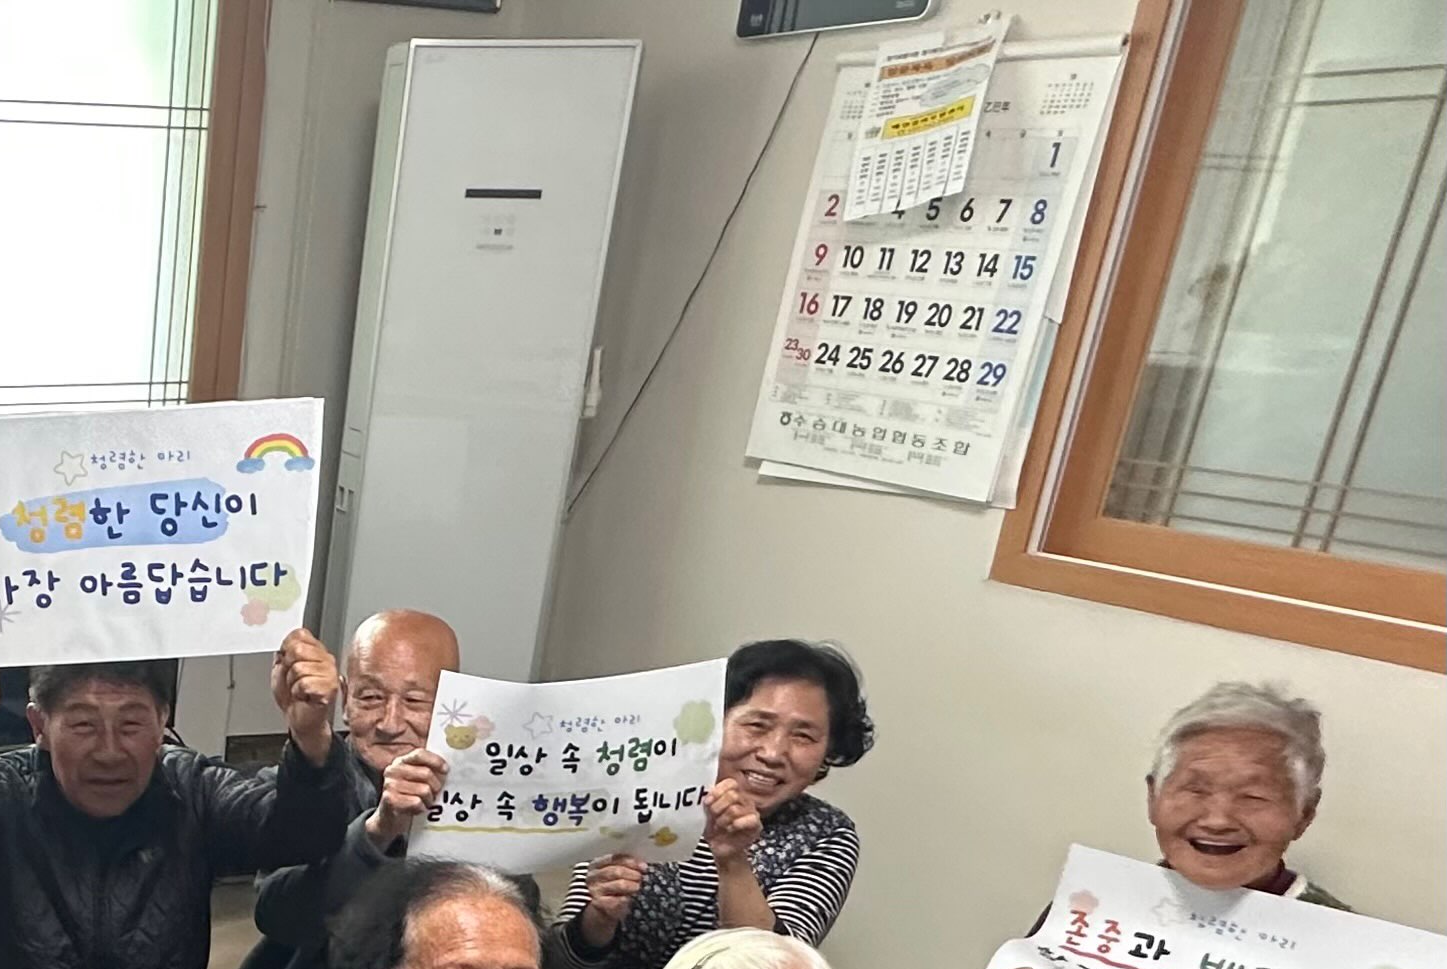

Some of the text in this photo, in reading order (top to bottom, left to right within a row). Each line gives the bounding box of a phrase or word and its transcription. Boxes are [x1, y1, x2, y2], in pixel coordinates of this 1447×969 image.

[1048, 142, 1062, 169] 1
[824, 194, 840, 217] 2
[926, 197, 942, 221] 5
[960, 198, 974, 222] 6
[996, 199, 1013, 224] 7
[1030, 200, 1048, 224] 8
[815, 244, 1037, 281] 9 10 11 12 13 14 15
[798, 292, 1022, 335] 16 17 18 19 20 21 22
[783, 338, 799, 352] 23
[795, 347, 811, 362] 30
[815, 342, 1007, 387] 24 25 26 27 28 29
[157, 450, 191, 462] 마리
[12, 491, 257, 543] 청렴한 당신이
[80, 558, 288, 605] 아름답습니다
[614, 715, 641, 725] 마리
[486, 737, 677, 776] 일상 속 청렴이
[496, 791, 516, 820] 속
[532, 792, 619, 827] 행복이
[633, 785, 708, 824] 됩니다
[1064, 909, 1171, 961] 존중과
